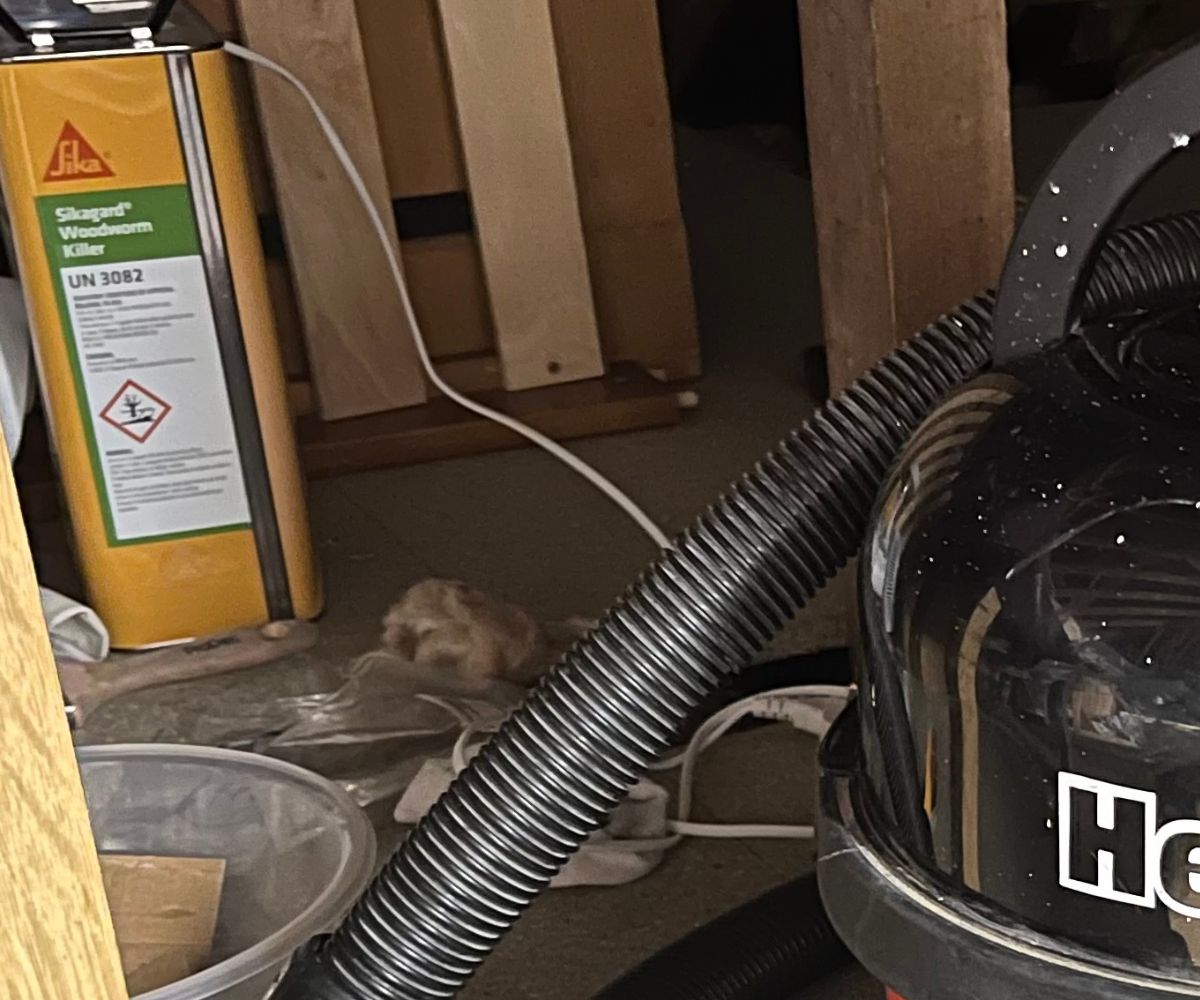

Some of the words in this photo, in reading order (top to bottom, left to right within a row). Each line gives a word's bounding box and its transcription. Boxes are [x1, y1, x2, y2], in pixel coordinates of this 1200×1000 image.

[50, 140, 102, 176] Sika
[59, 222, 154, 240] Woodworm
[62, 243, 105, 258] Killer
[68, 273, 96, 288] UN
[101, 269, 143, 285] 3082
